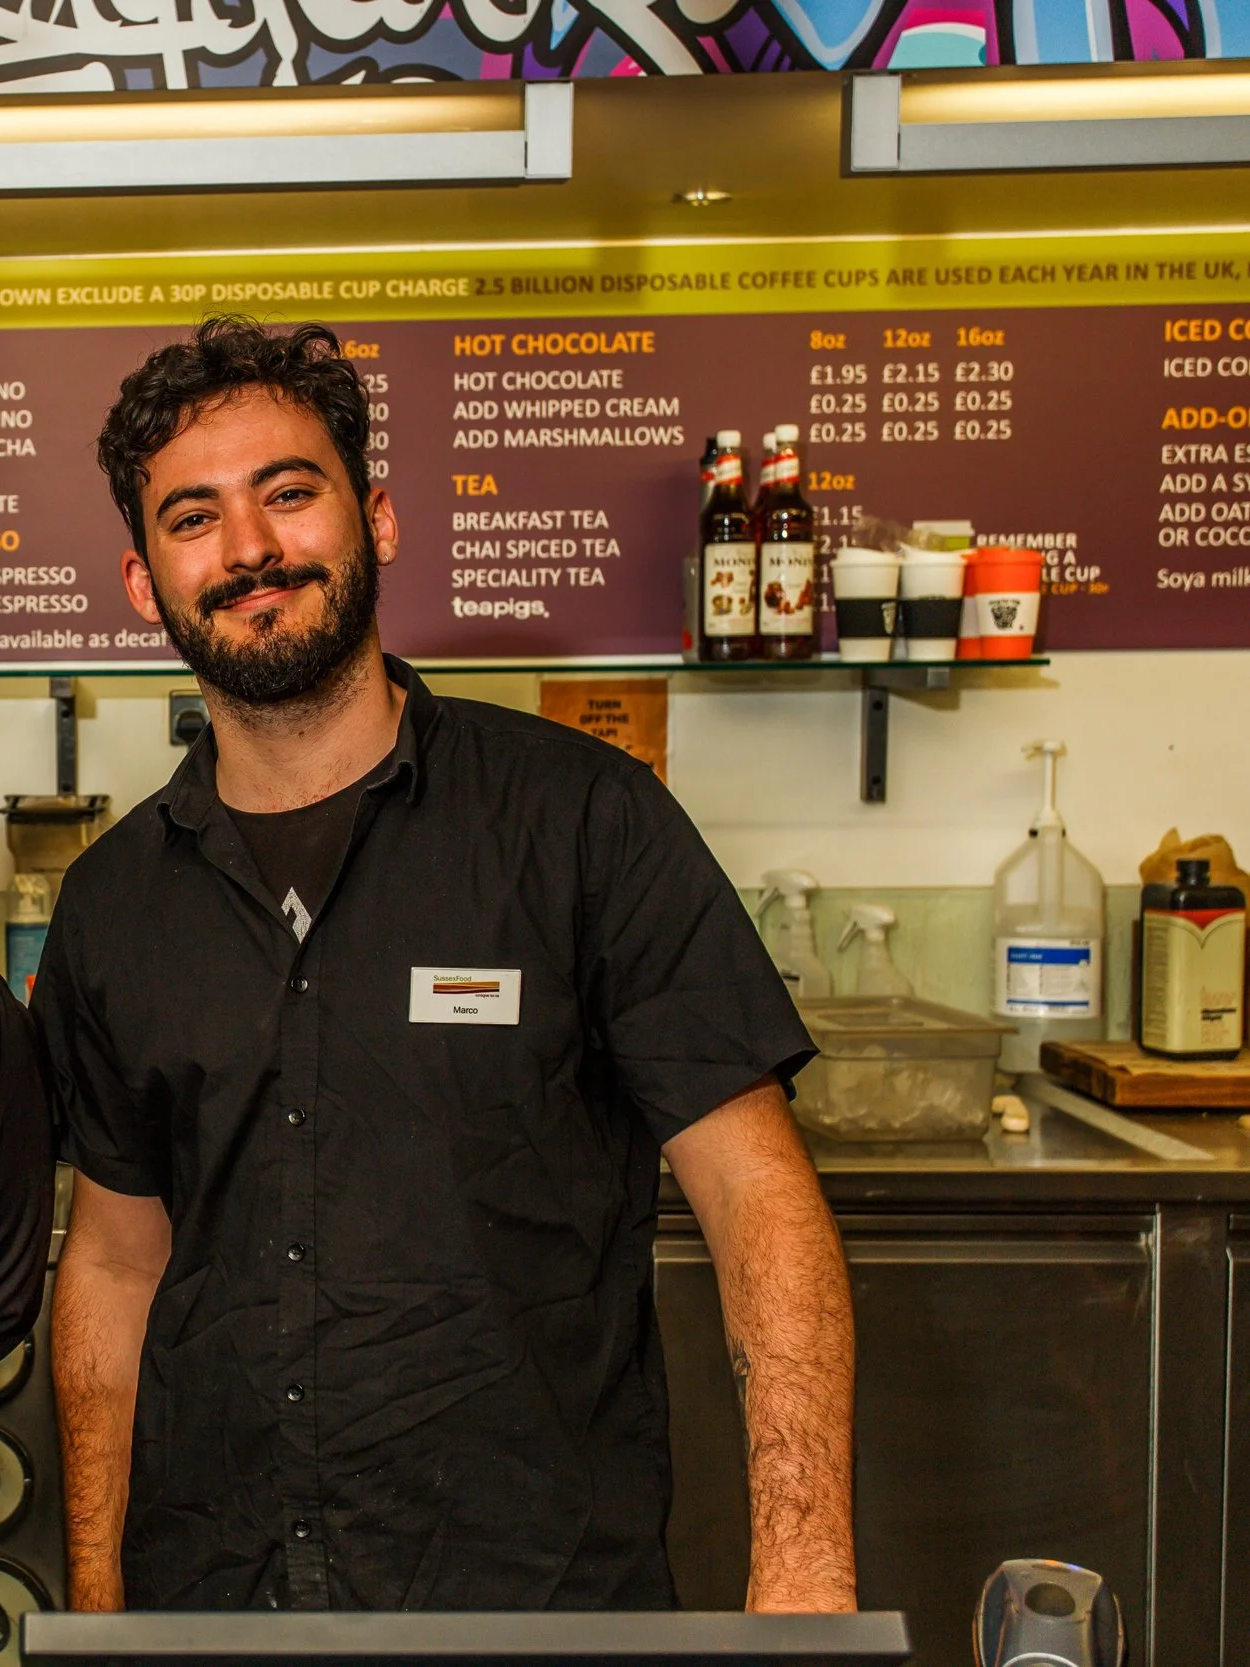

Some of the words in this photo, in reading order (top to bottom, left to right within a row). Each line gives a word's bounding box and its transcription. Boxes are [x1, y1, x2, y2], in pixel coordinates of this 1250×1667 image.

[475, 277, 505, 296] 2.5
[511, 275, 594, 295] BILLION
[600, 272, 731, 293] DISPOSABLE
[738, 270, 816, 290] COFFEE
[823, 269, 879, 288] CUPS
[885, 268, 927, 286] ARE
[935, 267, 992, 285] USED
[1000, 264, 1056, 284] EACH
[1063, 263, 1119, 283] YEAR
[1126, 263, 1149, 281] IN
[1155, 261, 1197, 280] THE
[1204, 260, 1241, 282] UK,
[57, 285, 144, 305] EXCLUDE
[150, 285, 165, 303] A
[170, 285, 206, 302] 30P
[211, 281, 334, 302] DISPOSABLE
[339, 280, 381, 298] CUP
[386, 278, 469, 297] CHARGE
[809, 329, 847, 349] 8oz
[883, 328, 931, 348] 12oz
[957, 326, 1005, 346] 16oz
[1165, 318, 1222, 342] ICED
[454, 334, 505, 356] HOT
[511, 331, 655, 355] CHOCOLATE
[810, 364, 867, 385] £1.95
[882, 362, 940, 383] £2.15
[955, 361, 1014, 382] £2.30
[1163, 357, 1212, 378] ICED
[1217, 355, 1250, 377] CO
[453, 371, 498, 391] HOT
[502, 369, 623, 390] CHOCOLATE
[453, 400, 498, 420] ADD
[504, 398, 600, 419] WHIPPED
[605, 396, 680, 417] CREAM
[810, 393, 867, 414] £0.25
[882, 391, 939, 412] £0.25
[954, 390, 1012, 411] £0.25
[1161, 406, 1250, 429] ADD-O
[453, 429, 498, 449] ADD
[504, 426, 685, 448] MARSHMALLOWS
[809, 422, 867, 443] £0.25
[881, 421, 939, 442] £0.25
[954, 419, 1012, 441] £0.25
[1161, 443, 1229, 465] EXTRA
[452, 473, 498, 496] TEA
[808, 471, 855, 491] 12oz
[1159, 472, 1207, 493] ADD
[1211, 472, 1228, 492] A
[452, 511, 565, 531] BREAKFAST
[570, 510, 609, 529] TEA
[1158, 502, 1206, 523] ADD
[977, 533, 1078, 549] REMEMBER
[1158, 526, 1189, 547] OR
[451, 540, 500, 560] CHAI
[506, 539, 577, 559] SPICED
[582, 538, 621, 558] TEA
[451, 567, 562, 588] SPECIALITY
[566, 567, 606, 586] TEA
[1064, 566, 1101, 583] CUP
[1156, 567, 1206, 592] Soya
[88, 632, 111, 648] as
[433, 974, 472, 983] SussexFood
[453, 1006, 479, 1015] Marco
